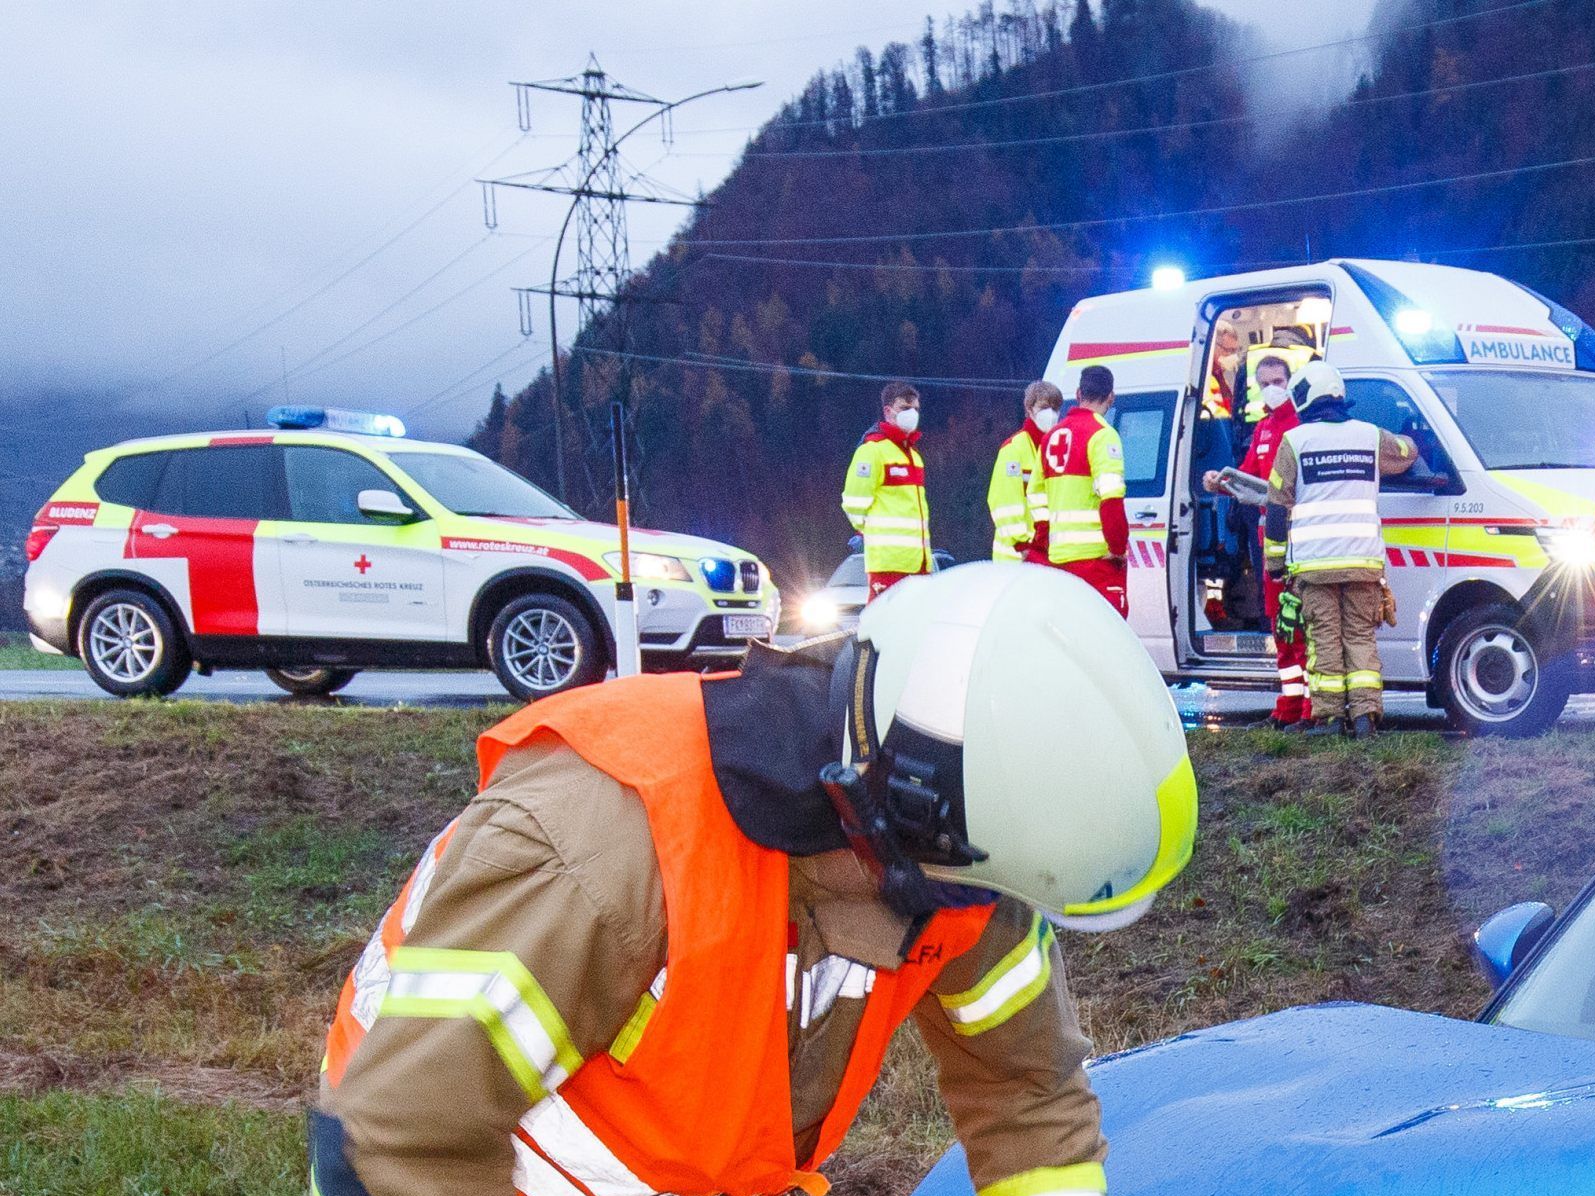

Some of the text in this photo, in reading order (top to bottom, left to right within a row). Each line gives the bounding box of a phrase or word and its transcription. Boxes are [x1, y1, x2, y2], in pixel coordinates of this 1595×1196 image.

[1470, 341, 1573, 363] AMBULANCE
[1315, 453, 1374, 465] LAGEFÜHRUNG
[48, 506, 98, 519] BLUDENZ
[1454, 502, 1484, 514] 9.5.203
[449, 540, 550, 556] www.roteskreuz.at
[399, 583, 423, 591] KREUZ
